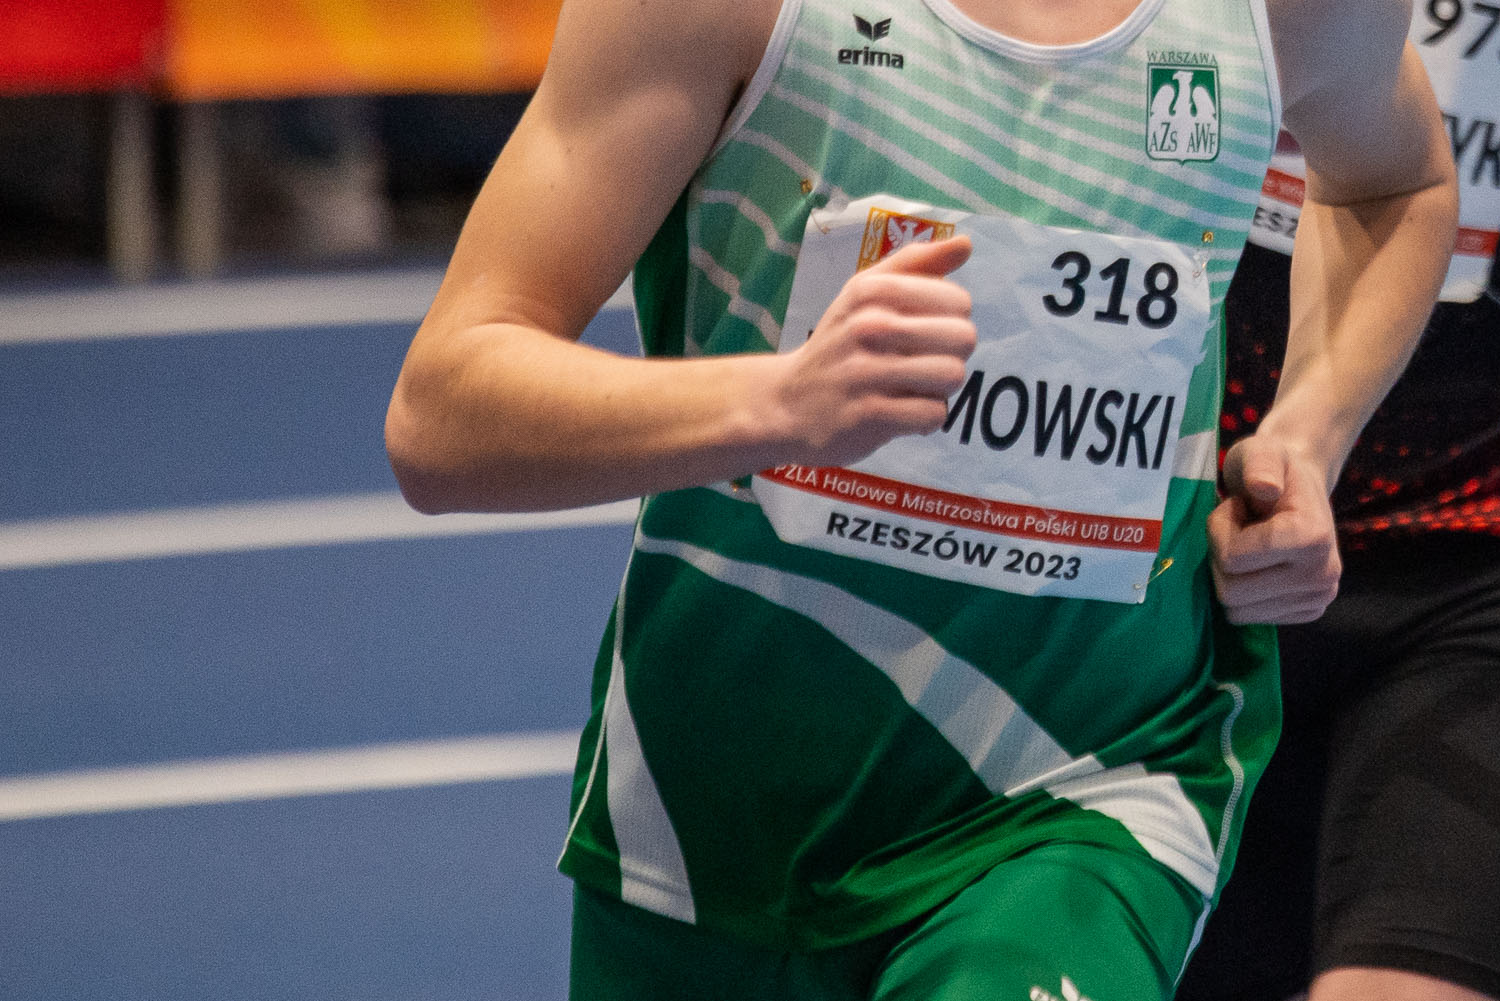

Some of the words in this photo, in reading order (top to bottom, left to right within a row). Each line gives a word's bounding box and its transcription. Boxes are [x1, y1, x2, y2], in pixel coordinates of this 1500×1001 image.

[838, 46, 904, 69] erima
[1147, 52, 1218, 66] WARSZAWA
[1150, 122, 1178, 153] AZS
[1186, 122, 1216, 154] AWF
[1042, 250, 1180, 330] 318
[941, 370, 1176, 471] MOWSKI
[823, 473, 898, 506] Halowe
[901, 491, 1019, 531] Mistrzostwa
[1023, 513, 1077, 539] Polski
[1080, 521, 1110, 541] U18
[1112, 526, 1144, 544] U20
[826, 511, 998, 569] RZESZÓW
[1002, 548, 1082, 581] 2023
